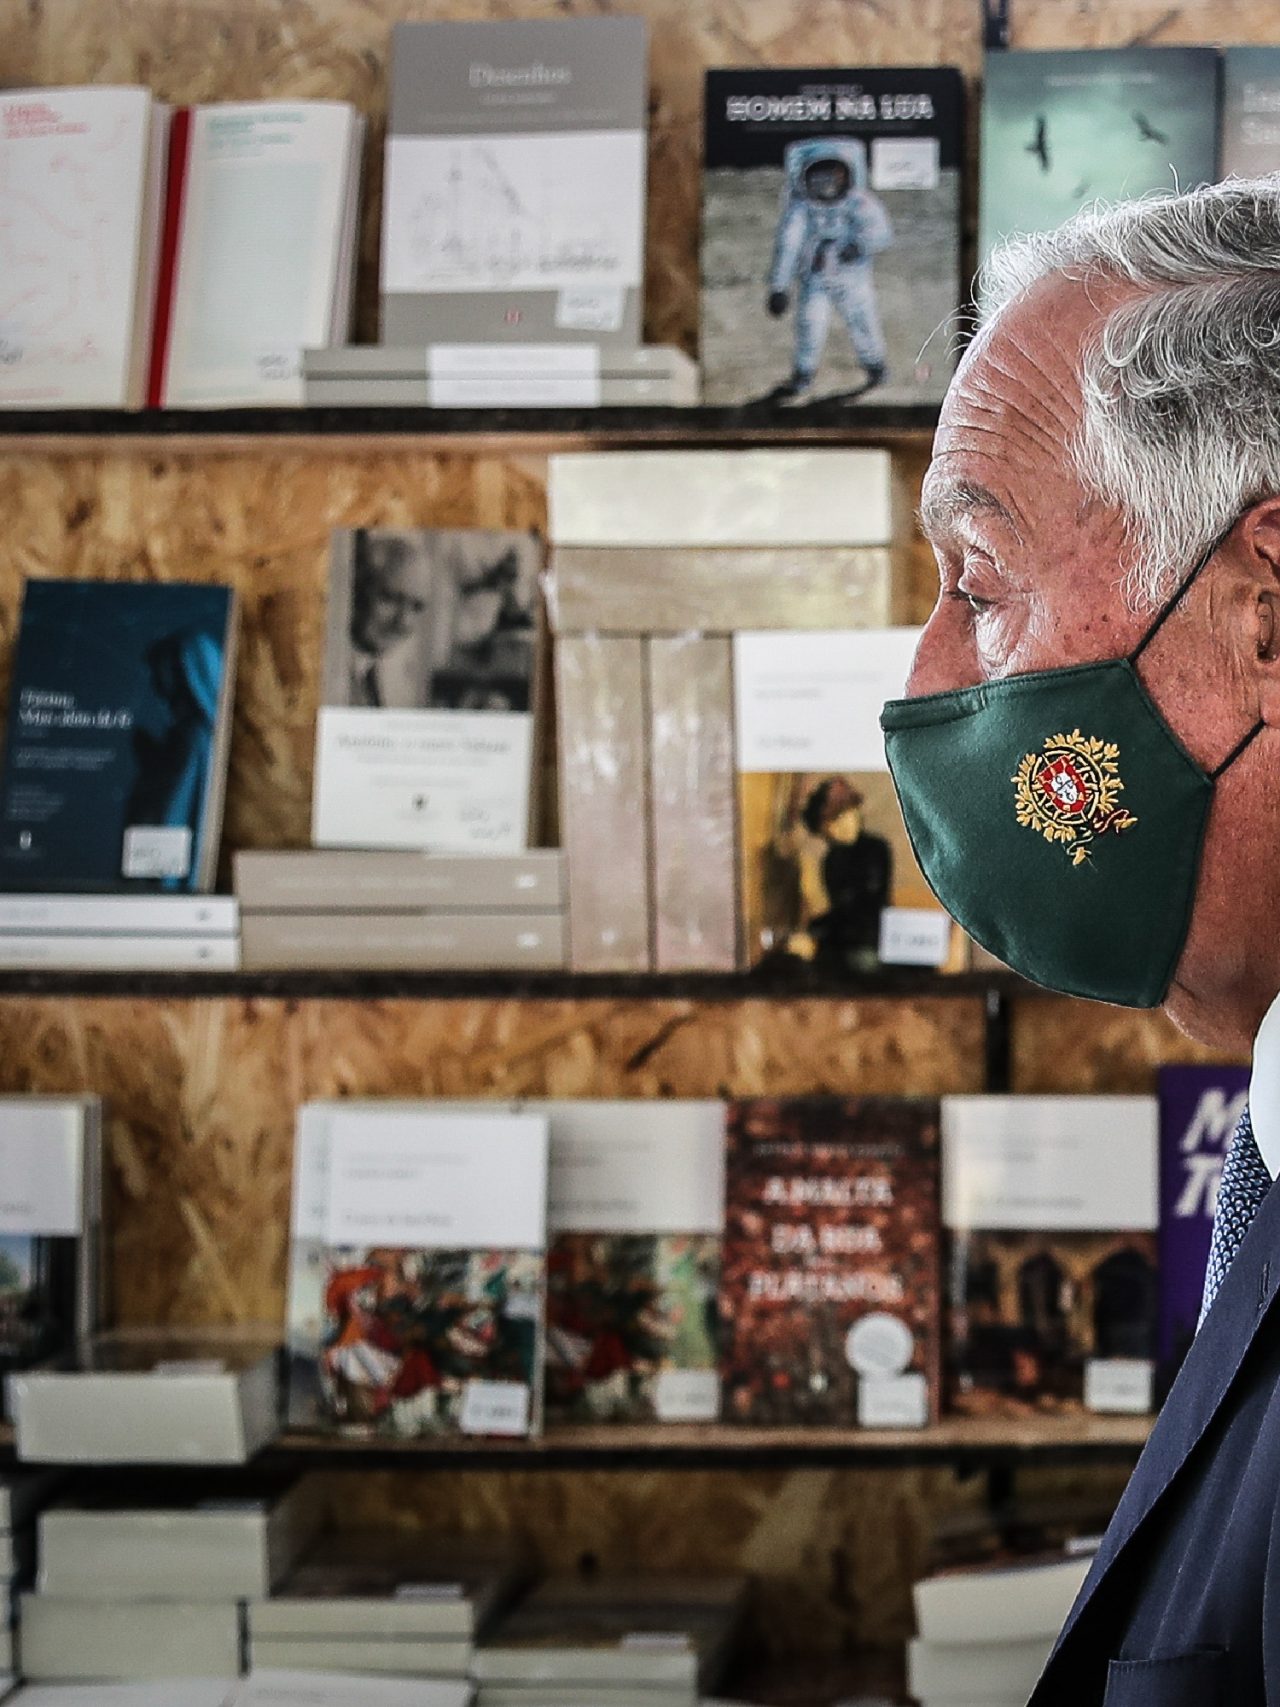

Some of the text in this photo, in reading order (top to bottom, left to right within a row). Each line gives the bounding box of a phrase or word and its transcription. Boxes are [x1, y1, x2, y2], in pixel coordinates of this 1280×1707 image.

[726, 94, 934, 121] HOMEM NA LUA
